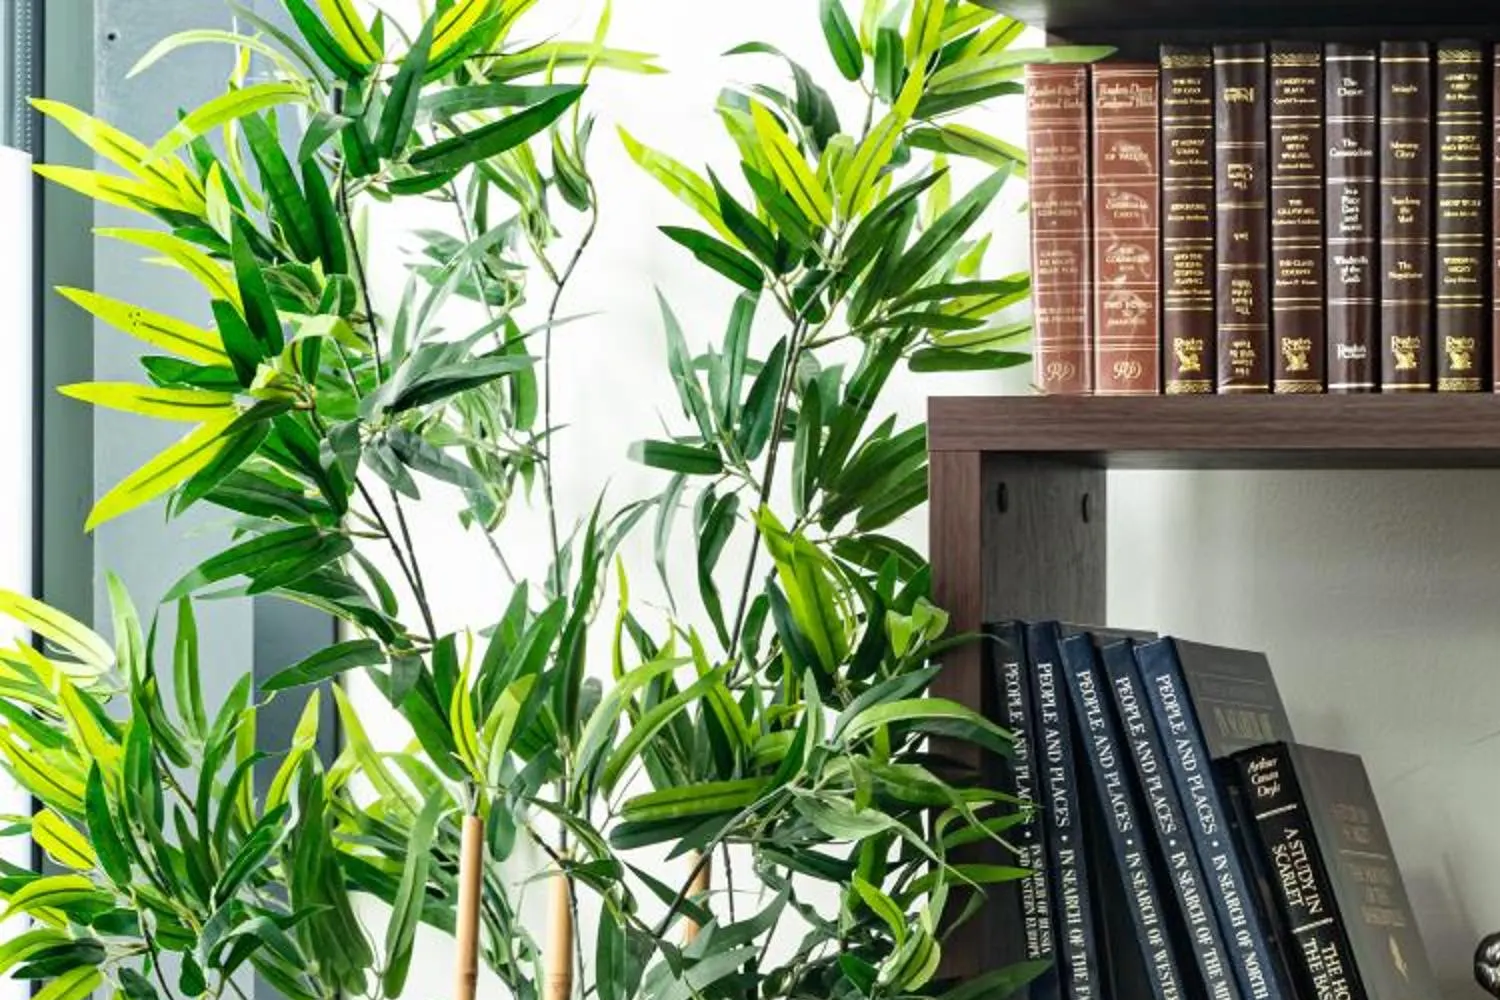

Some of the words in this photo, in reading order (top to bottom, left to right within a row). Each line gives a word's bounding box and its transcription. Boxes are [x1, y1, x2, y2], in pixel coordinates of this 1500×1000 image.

[1004, 661, 1025, 724] PEOPLE
[1037, 662, 1058, 725] PEOPLE
[1075, 670, 1106, 731] PEOPLE
[1115, 676, 1146, 738] PEOPLE
[1155, 672, 1187, 736] PEOPLE
[1045, 728, 1063, 764] AND
[1093, 734, 1117, 770] AND
[1133, 739, 1158, 775] AND
[1175, 737, 1199, 773] AND
[1049, 767, 1071, 829] PLACES
[1103, 771, 1133, 834] PLACES
[1145, 774, 1177, 837] PLACES
[1186, 773, 1218, 837] PLACES
[1283, 827, 1300, 841] A
[1059, 849, 1075, 866] IN
[1125, 852, 1143, 869] IN
[1170, 851, 1187, 869] IN
[1210, 853, 1229, 872] IN
[1271, 842, 1306, 909] SCARLET
[1288, 839, 1318, 892] STUDY
[1061, 869, 1083, 925] SEARCH
[1130, 870, 1159, 926] SEARCH
[1176, 869, 1208, 926] SEARCH
[1216, 872, 1247, 928] SEARCH
[1305, 891, 1324, 916] IN
[1068, 928, 1084, 948] OF
[1147, 929, 1165, 951] OF
[1195, 927, 1213, 947] OF
[1235, 928, 1255, 950] OF
[1070, 951, 1089, 985] THE
[1202, 947, 1223, 981] THE
[1302, 937, 1325, 974] THE
[1321, 941, 1344, 977] THE
